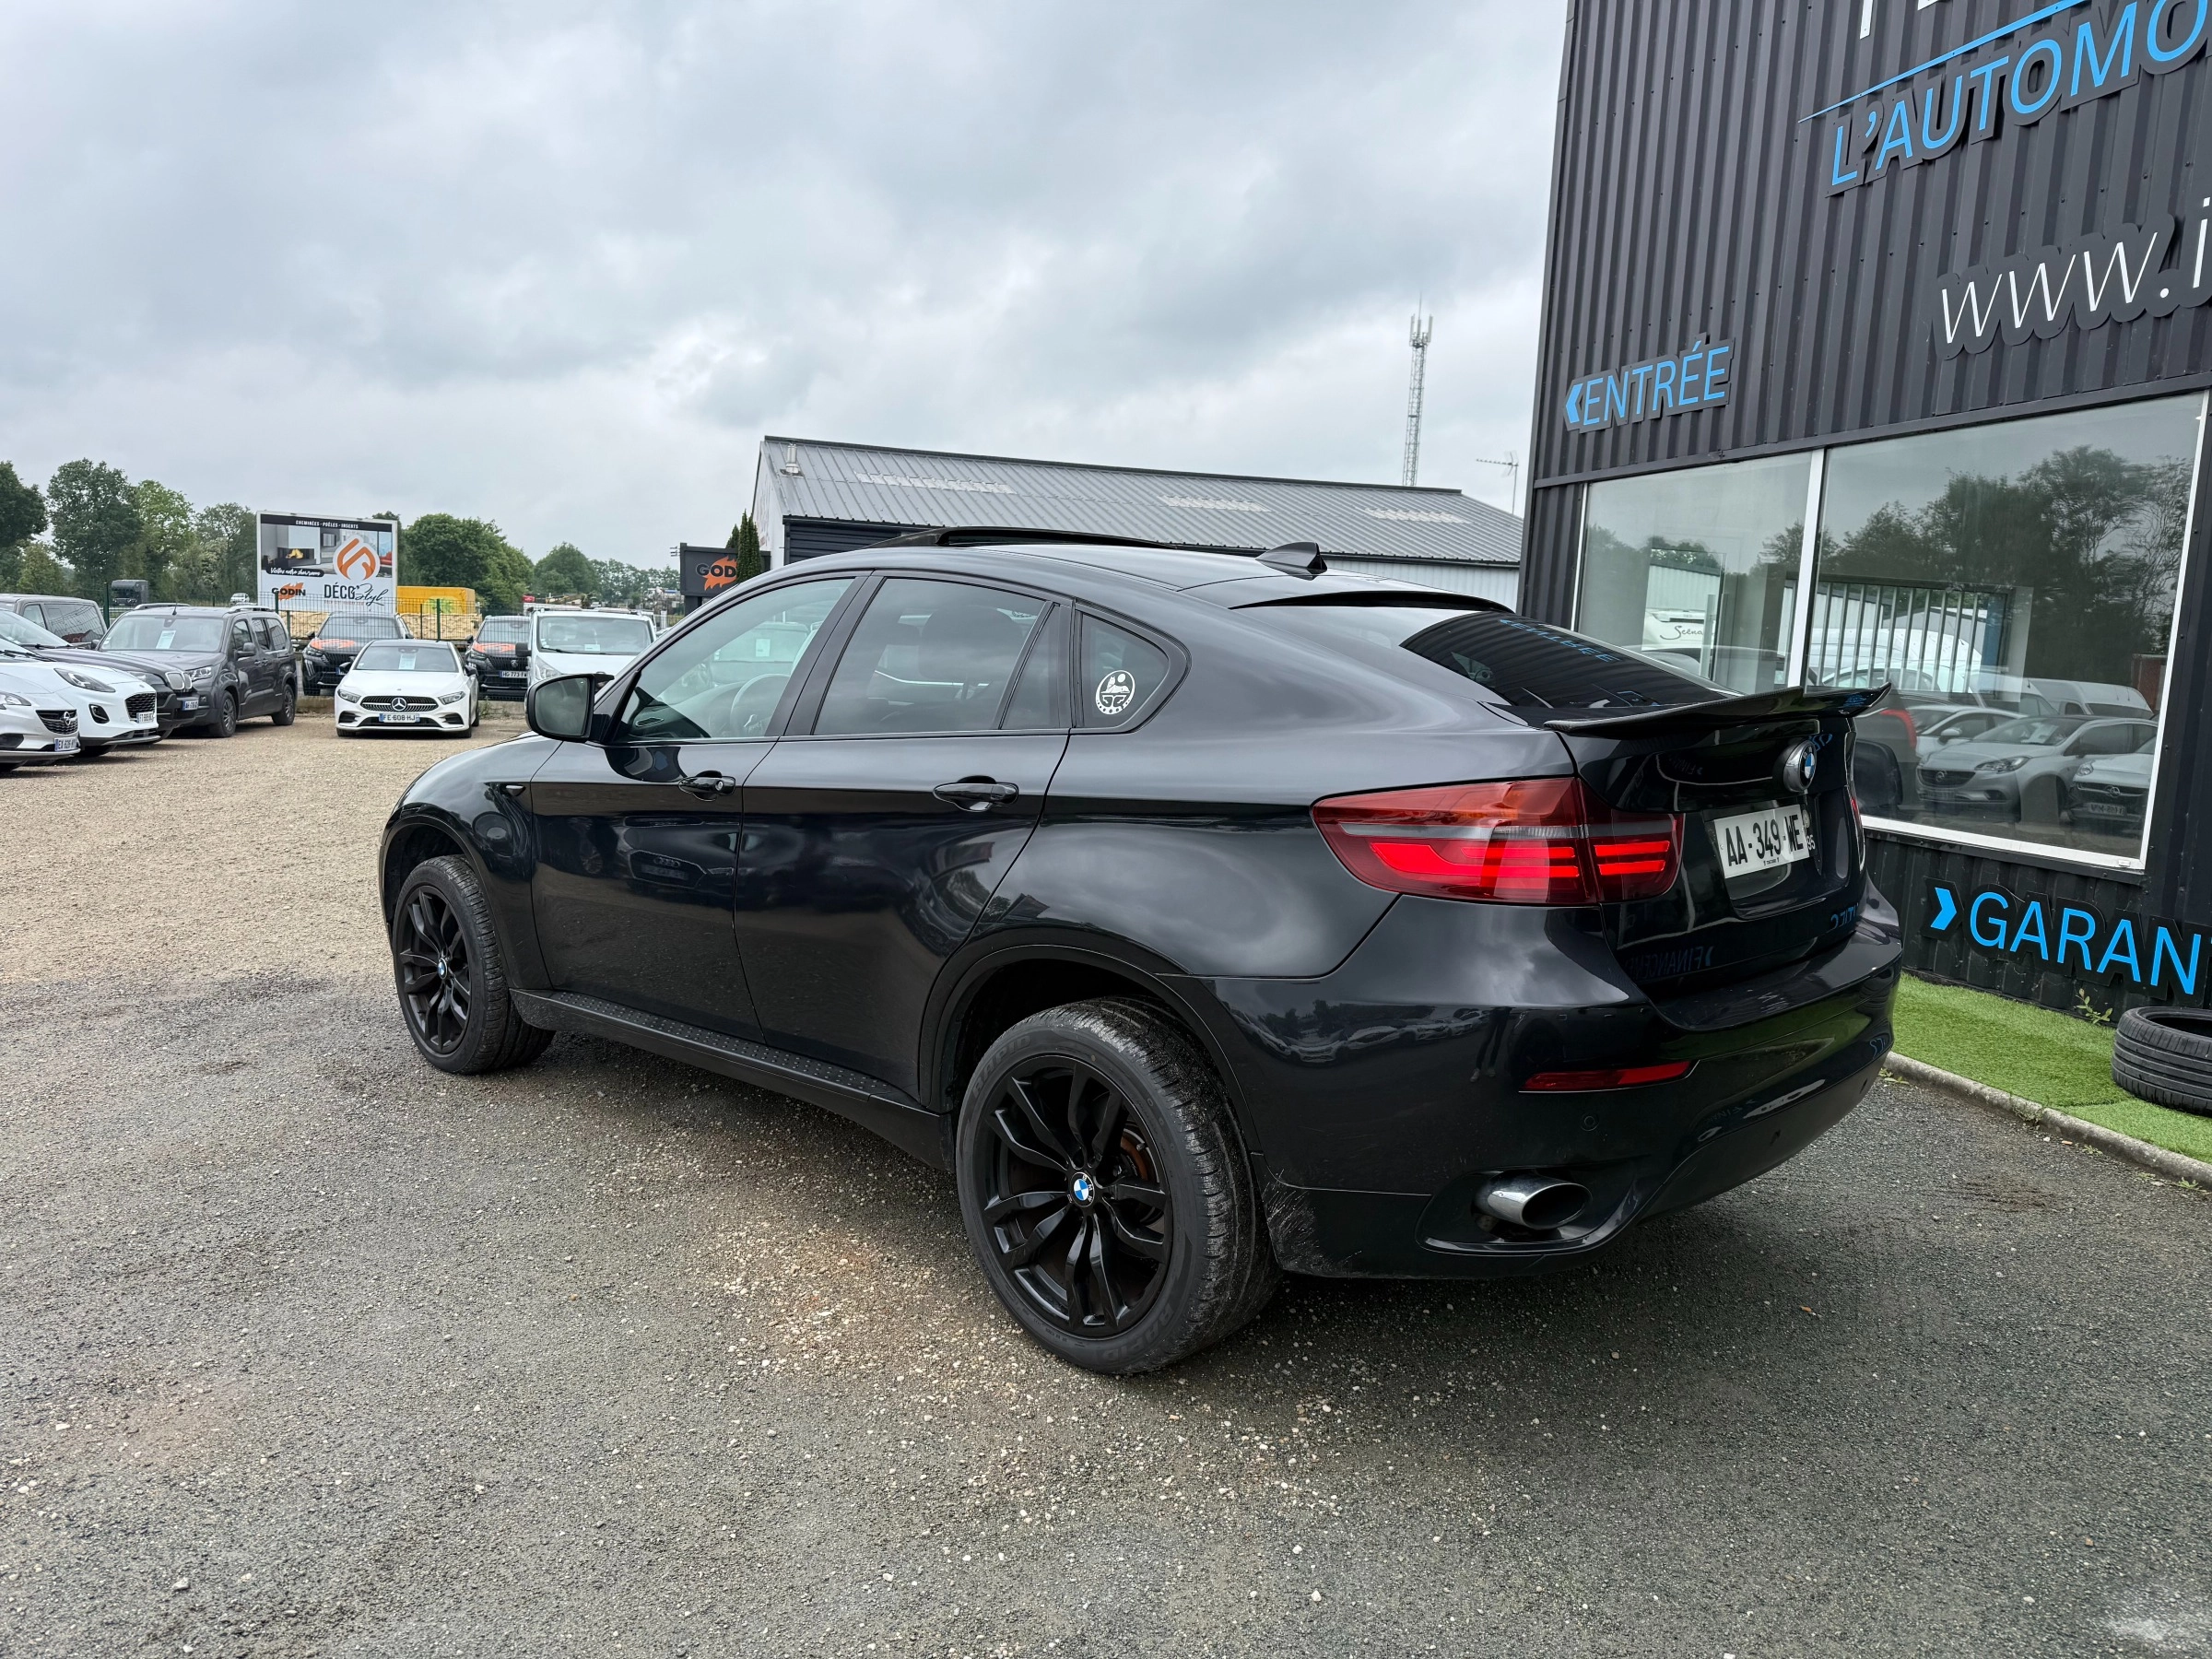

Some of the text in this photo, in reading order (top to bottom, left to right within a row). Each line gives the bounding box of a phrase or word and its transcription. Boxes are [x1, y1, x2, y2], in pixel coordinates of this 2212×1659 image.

[1831, 0, 2208, 185] L'AUTOMO
[1583, 340, 1730, 426] ENTRÉE
[271, 587, 306, 596] GODIN
[696, 562, 737, 578] GOD
[1970, 891, 2212, 996] GARAN
[971, 1035, 1031, 1099] RAPID
